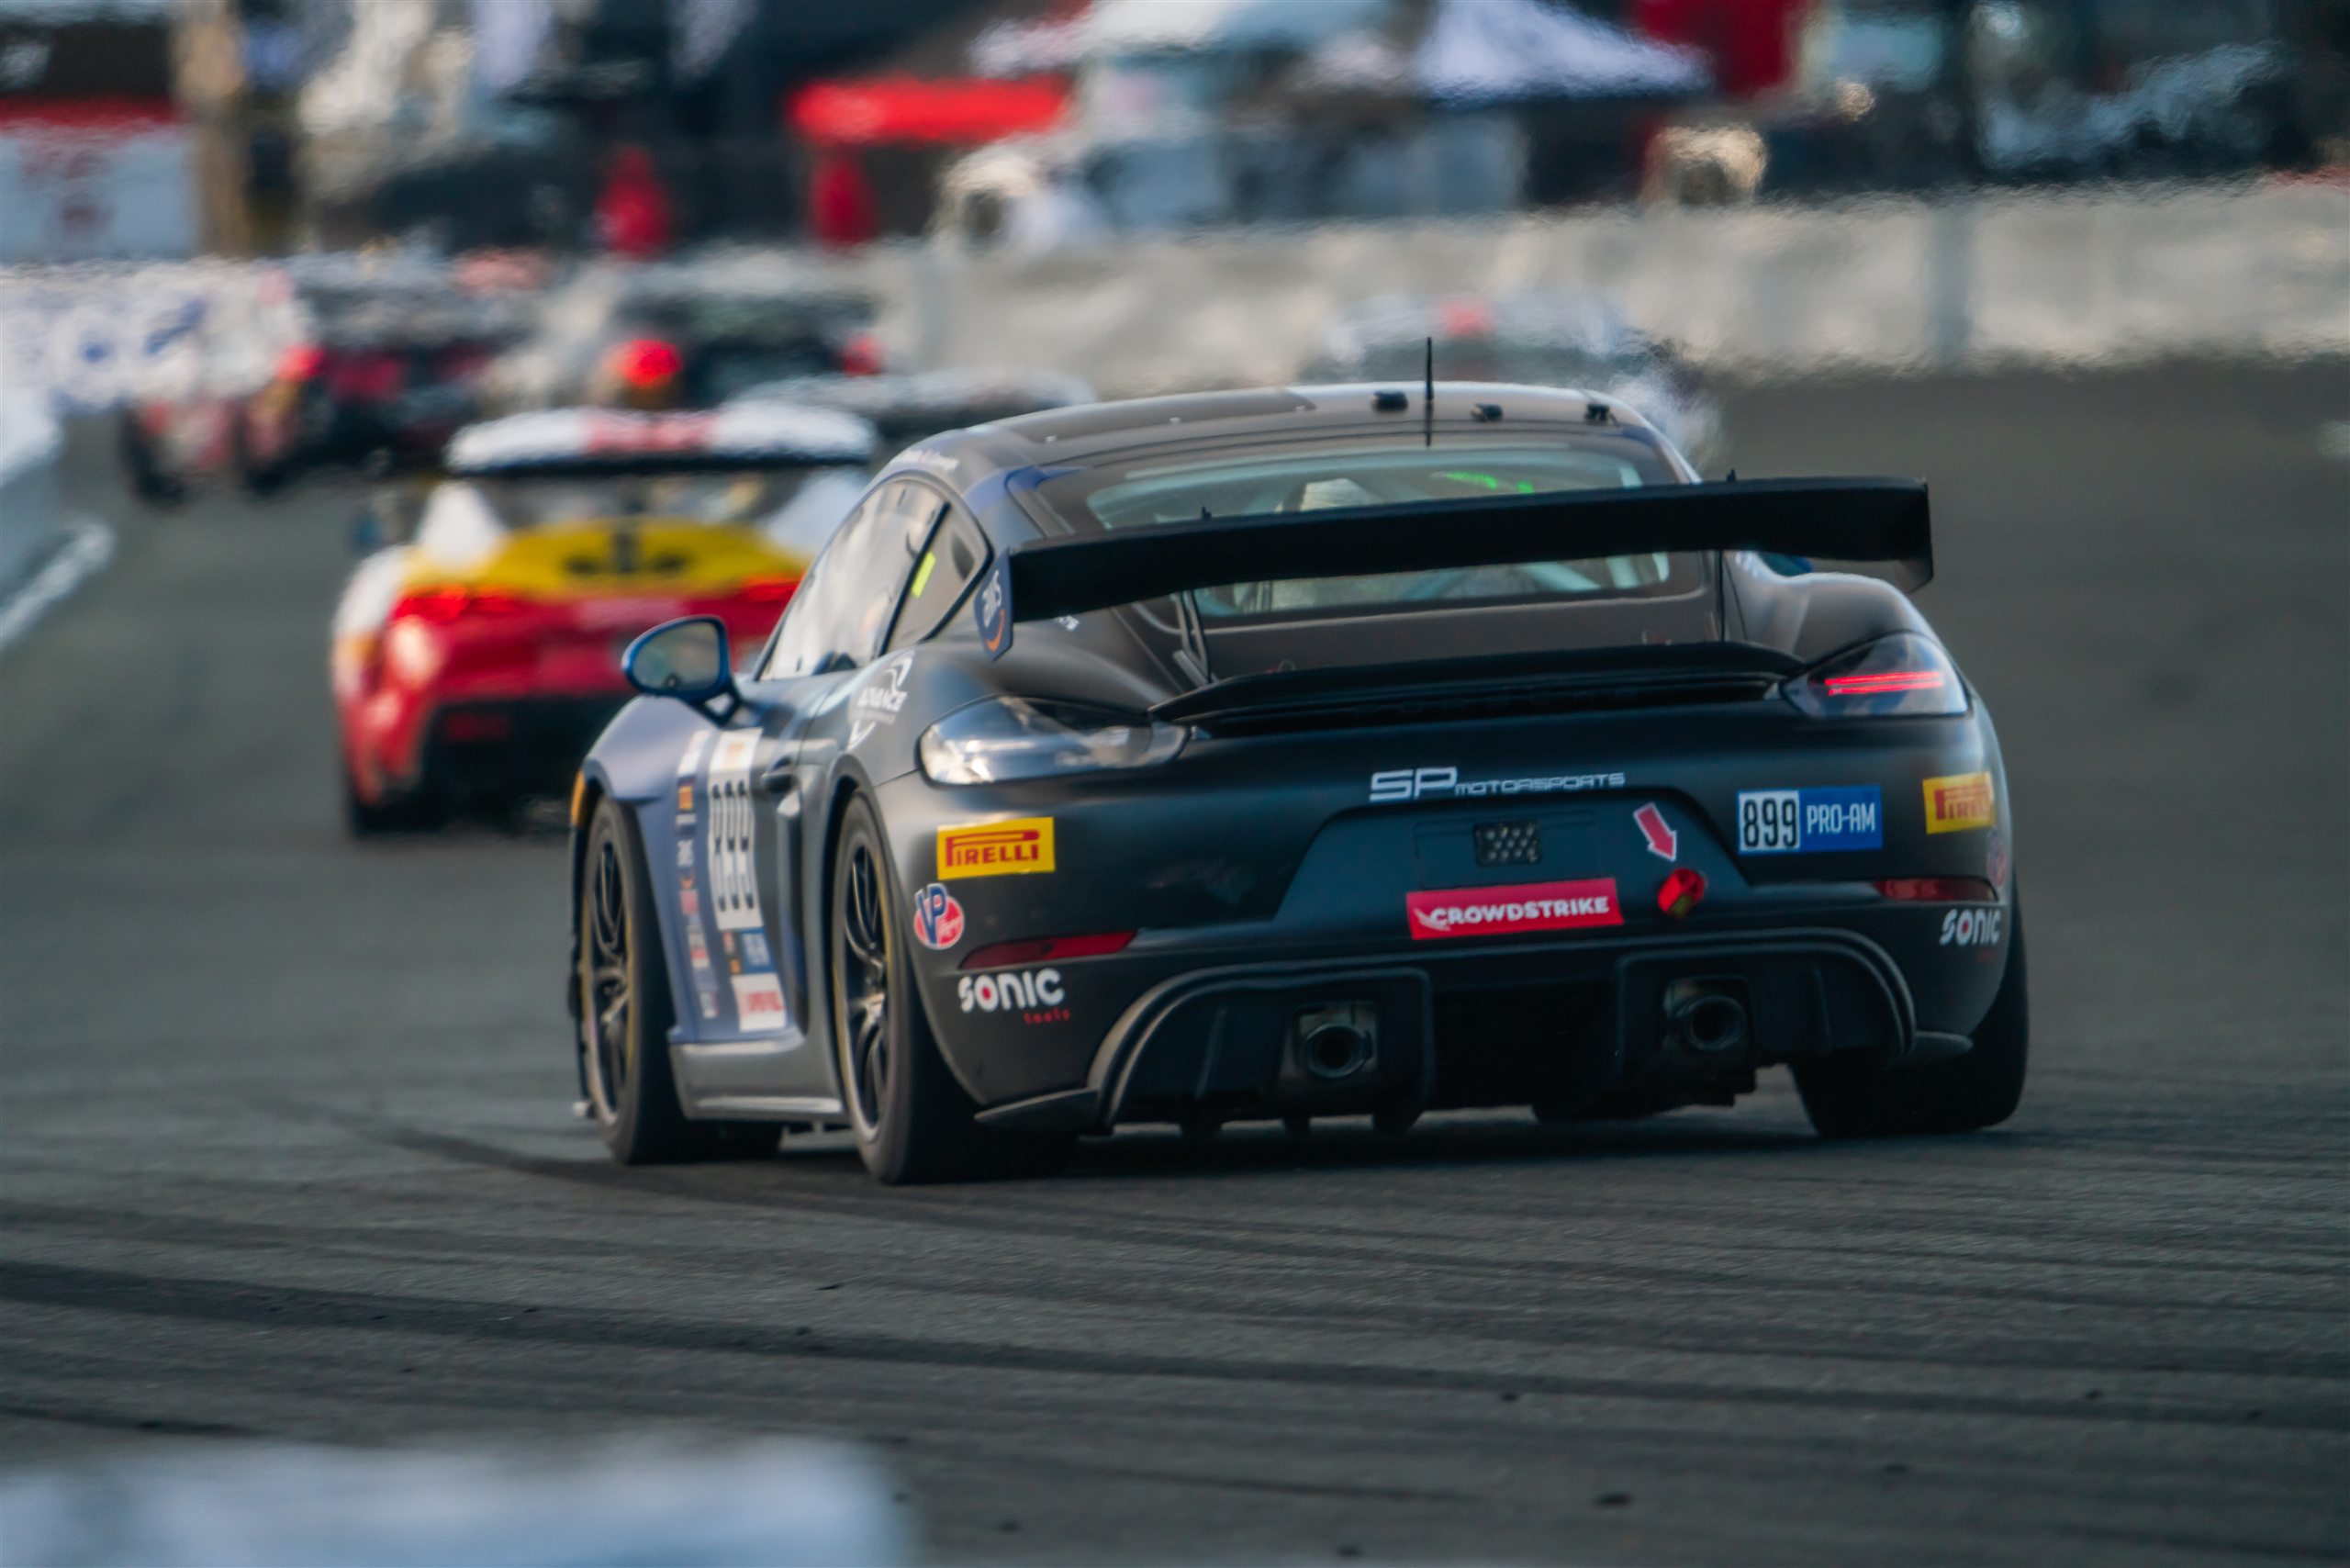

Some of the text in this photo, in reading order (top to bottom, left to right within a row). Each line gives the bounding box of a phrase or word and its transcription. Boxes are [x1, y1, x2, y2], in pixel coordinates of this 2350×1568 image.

[1370, 767, 1626, 801] SP MOTORSPORTS
[1742, 798, 1876, 848] 899 PRO-AM
[946, 829, 1041, 868] PIRELLI
[1428, 896, 1610, 928] CROWDSTRIKE
